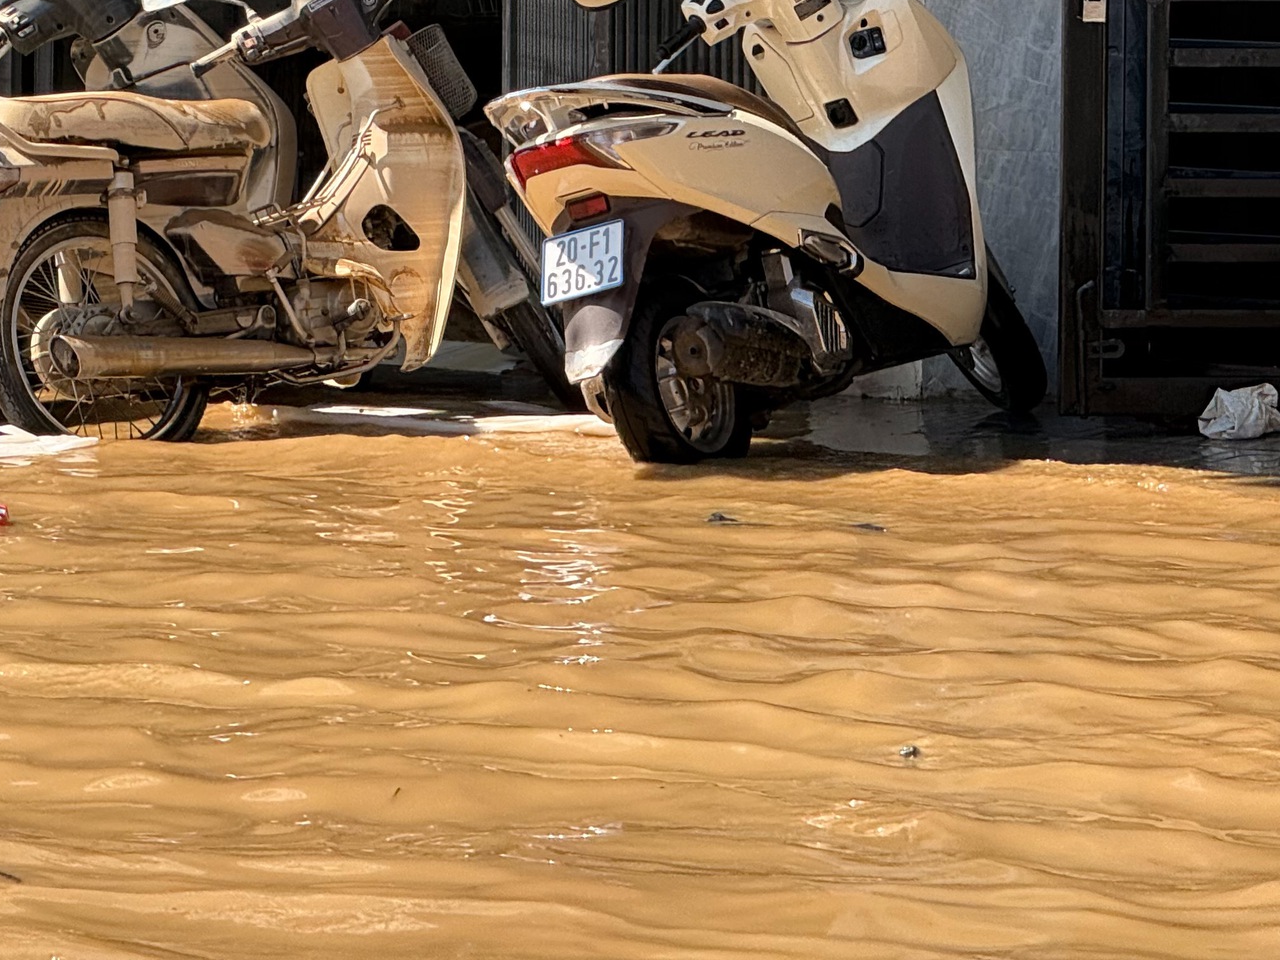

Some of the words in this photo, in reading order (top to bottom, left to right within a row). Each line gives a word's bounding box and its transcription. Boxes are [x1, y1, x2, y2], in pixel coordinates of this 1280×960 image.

[686, 129, 746, 139] LEAD
[555, 226, 611, 268] 20-F1
[547, 255, 619, 299] 636.32
